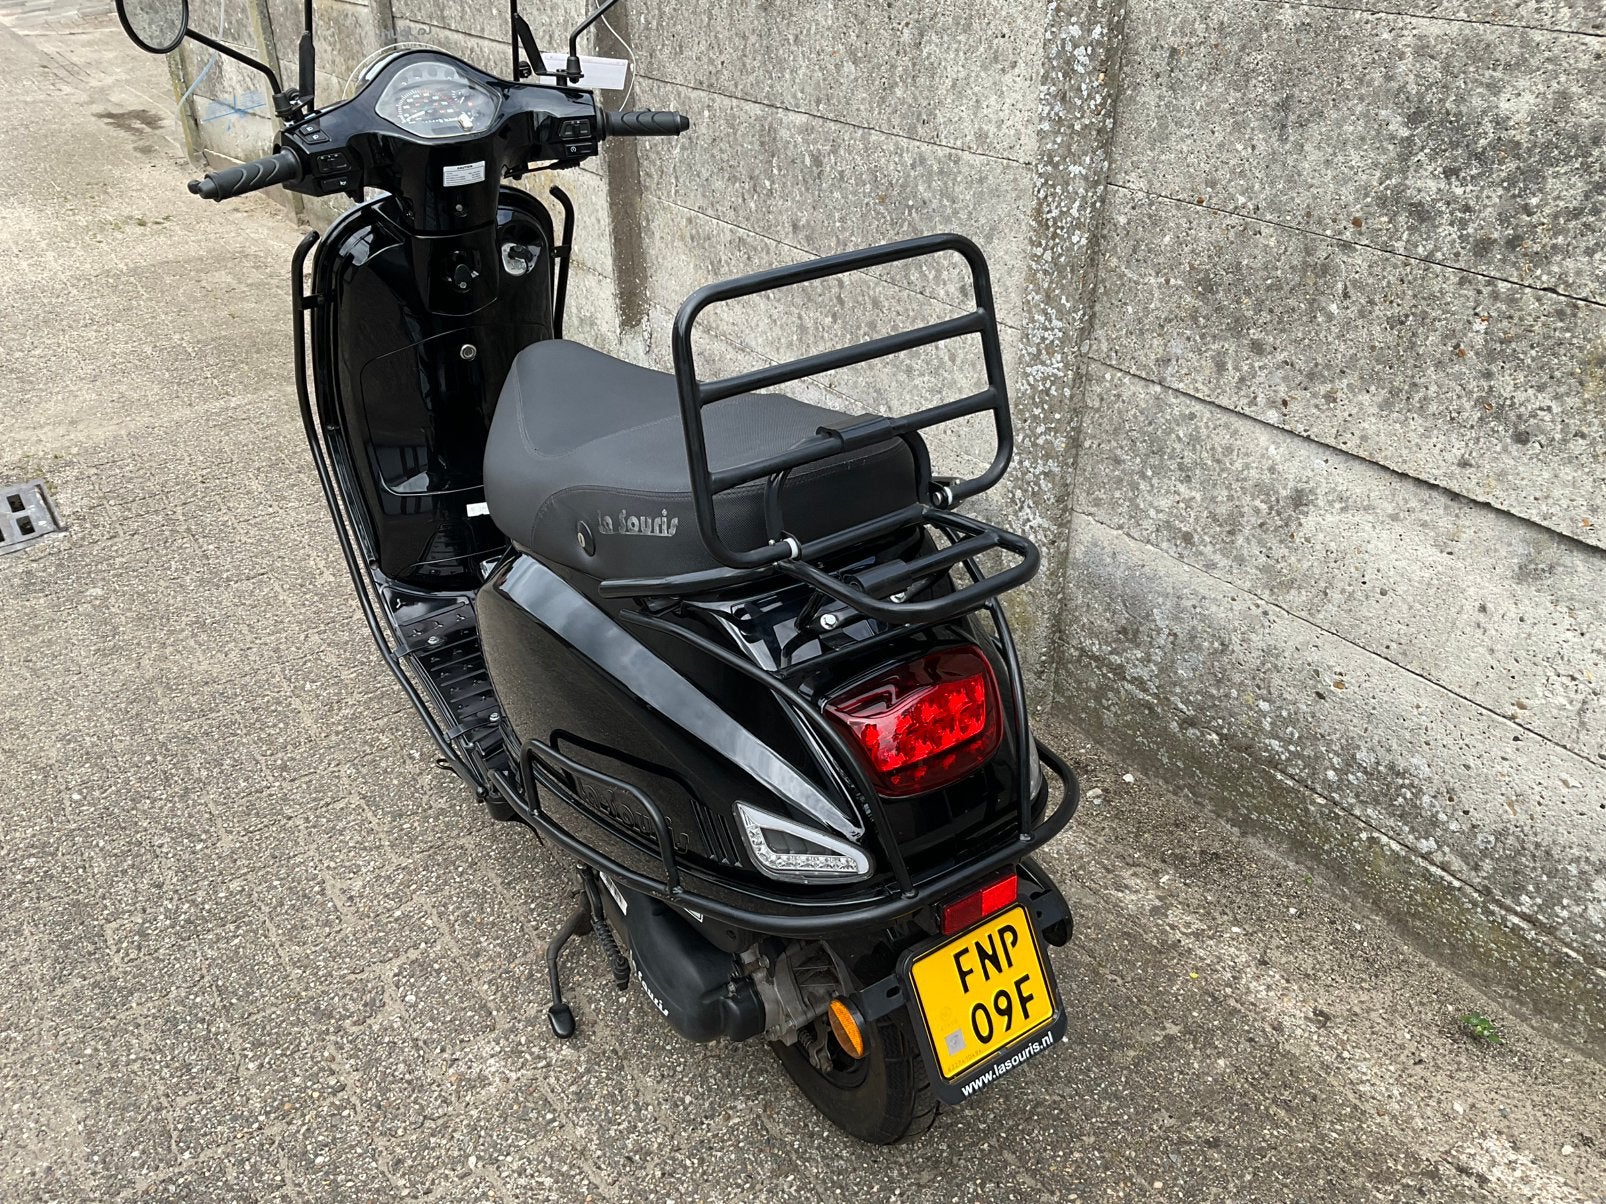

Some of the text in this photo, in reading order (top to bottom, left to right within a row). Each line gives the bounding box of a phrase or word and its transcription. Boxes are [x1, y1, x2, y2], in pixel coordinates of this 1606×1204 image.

[618, 507, 679, 537] Souris
[952, 924, 1019, 994] FNP
[970, 973, 1035, 1045] 09F
[960, 1030, 1054, 1097] www.lasouris.nl
